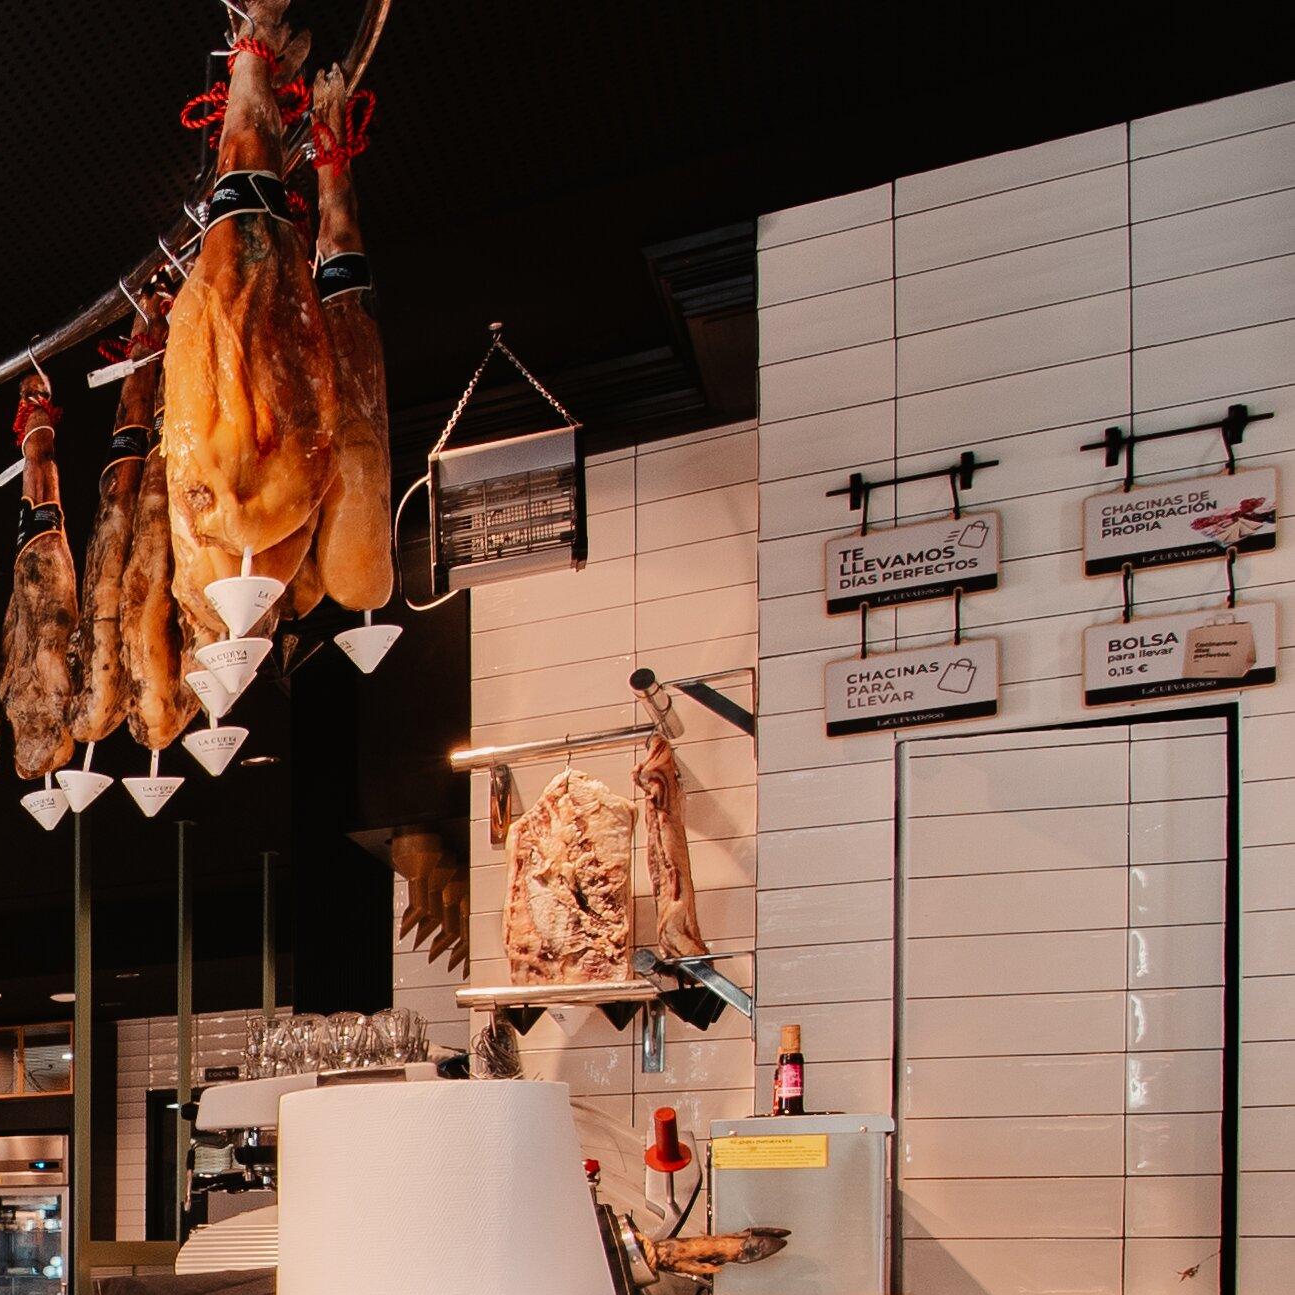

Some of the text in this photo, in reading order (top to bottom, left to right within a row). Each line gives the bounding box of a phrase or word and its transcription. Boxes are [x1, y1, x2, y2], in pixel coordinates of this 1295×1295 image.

[1101, 490, 1210, 517] CHACINAS DE
[1101, 500, 1218, 528] ELABORACIÓN
[1101, 521, 1162, 539] PROPIA
[839, 548, 864, 563] TE
[840, 545, 956, 577] LLEVAMOS
[840, 558, 979, 590] DÍAS PERFECTOS
[1108, 632, 1179, 652] BOLSA
[1107, 647, 1174, 664] para llevar
[846, 662, 940, 685] CHACINAS
[1108, 664, 1148, 677] 0,15 €
[847, 682, 895, 697] PARA
[847, 691, 914, 709] LLEVAR
